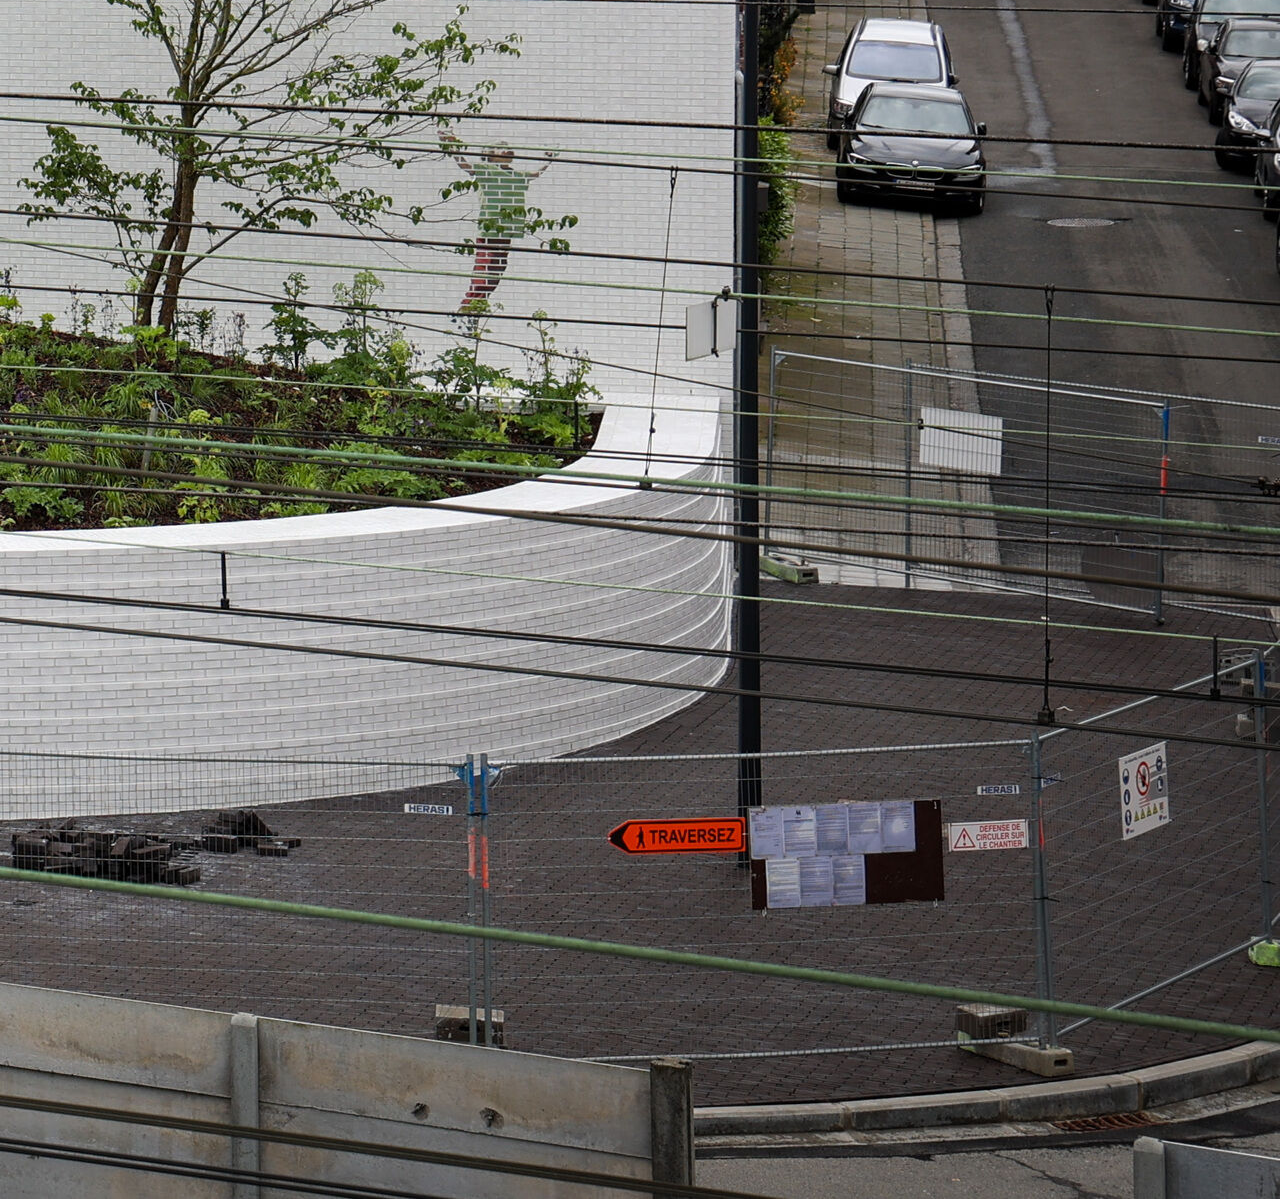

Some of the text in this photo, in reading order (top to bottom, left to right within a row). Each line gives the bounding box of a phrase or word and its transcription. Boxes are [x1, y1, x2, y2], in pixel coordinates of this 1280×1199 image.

[1011, 823, 1021, 831] DE
[649, 827, 736, 844] TRAVERSEZ
[975, 831, 1025, 841] CIRCULER SUR
[979, 840, 1022, 849] LE CHANTIER
